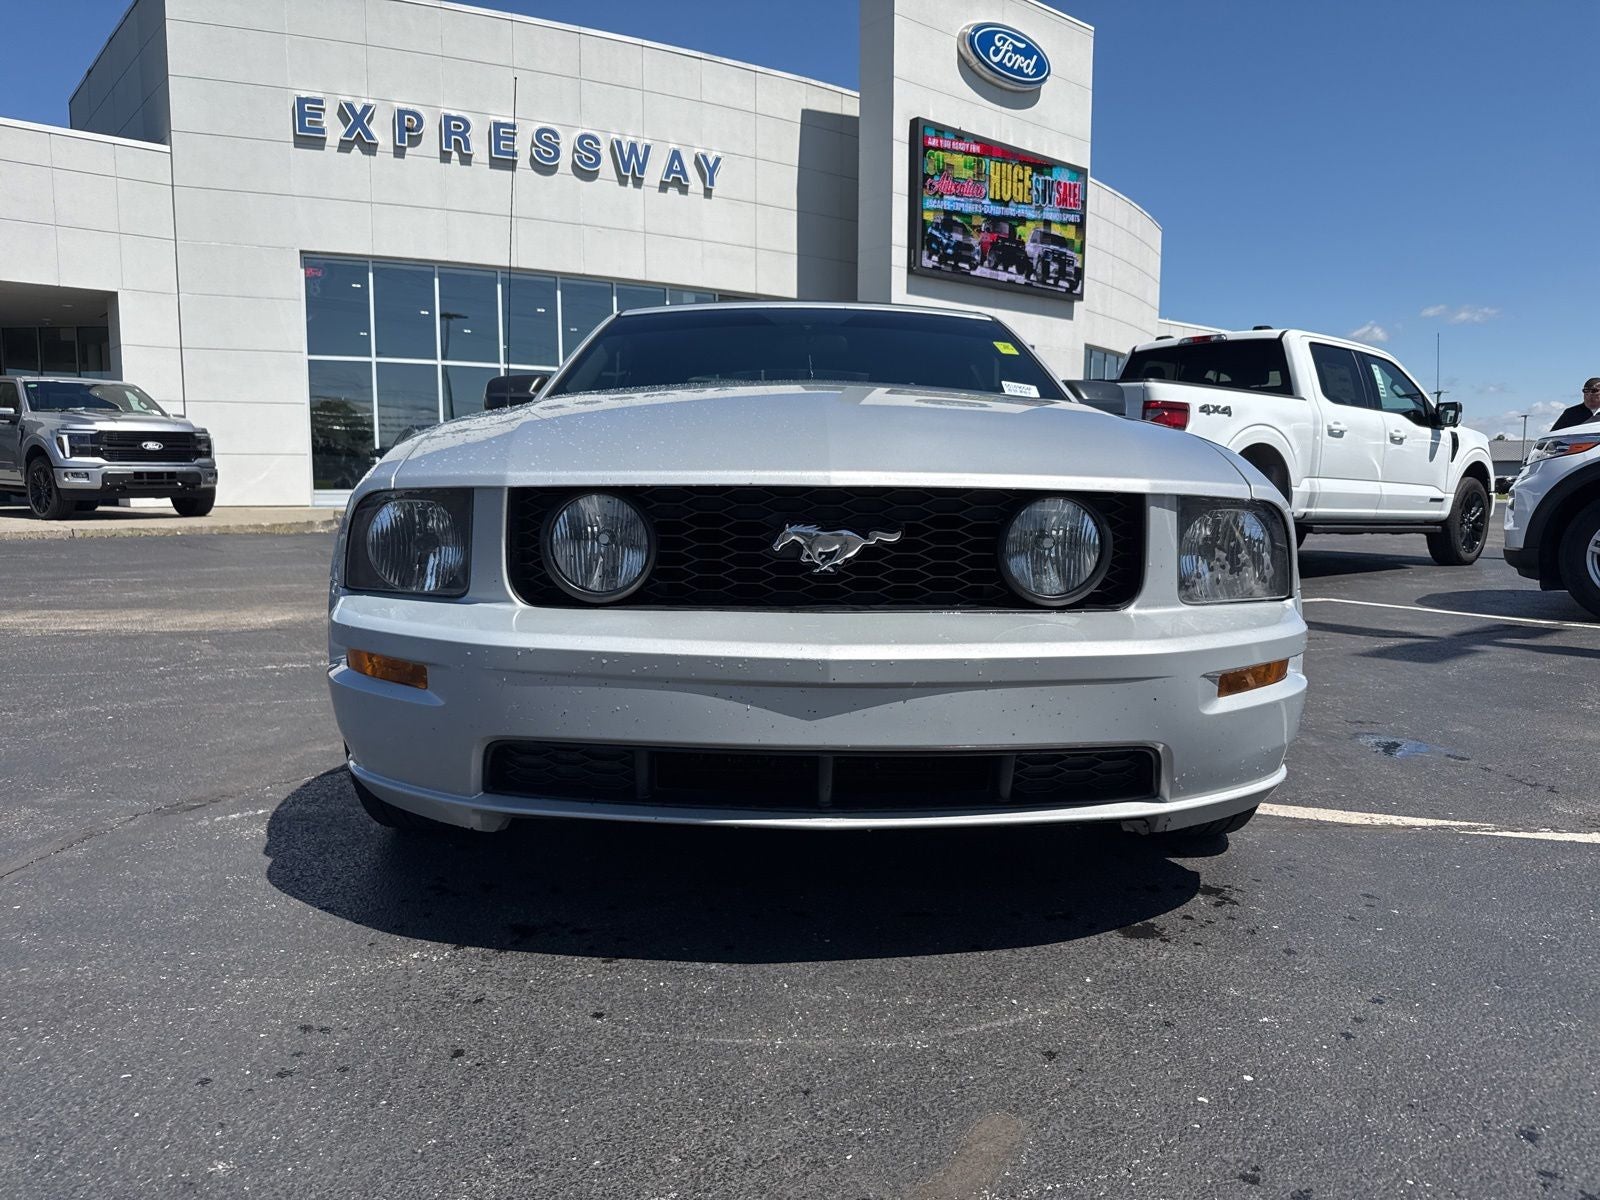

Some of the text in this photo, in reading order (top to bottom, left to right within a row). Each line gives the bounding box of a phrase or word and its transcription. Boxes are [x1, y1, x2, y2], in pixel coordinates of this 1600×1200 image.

[989, 33, 1038, 75] Ford
[293, 95, 723, 190] EXPRESSWAY
[989, 160, 1081, 210] HUGE SUV SALE!
